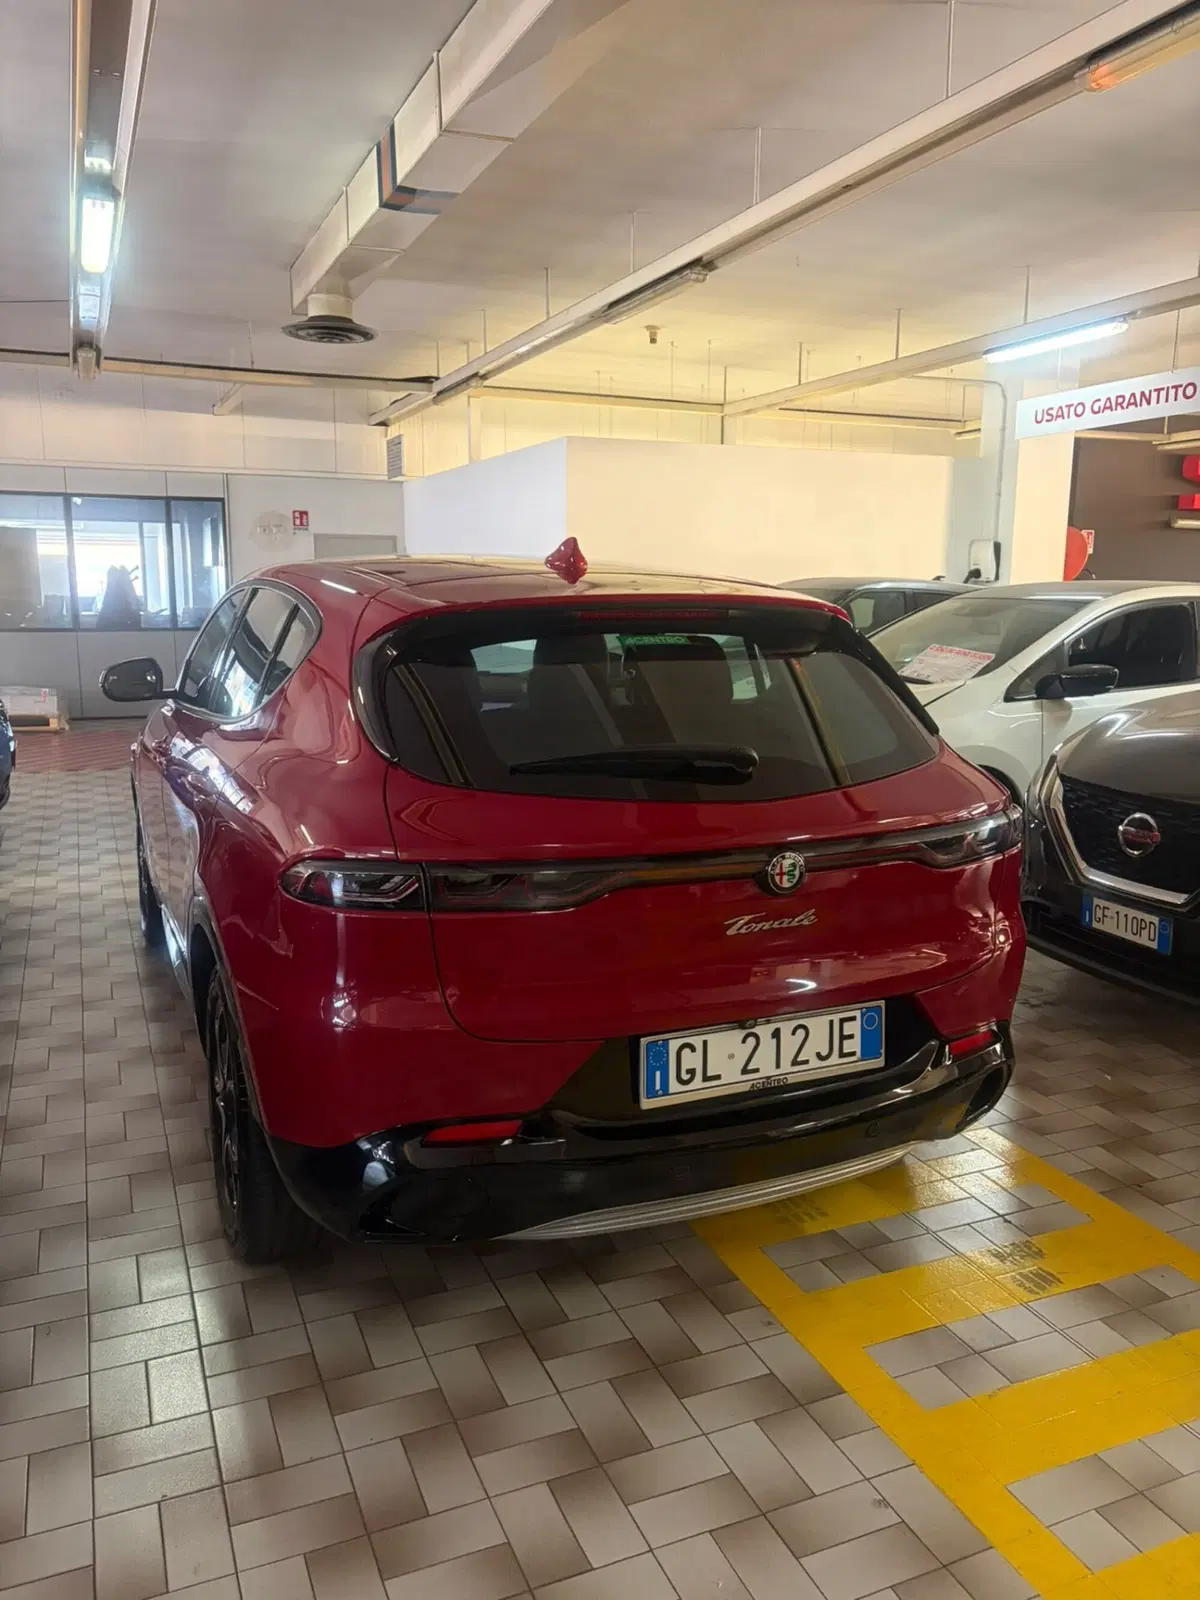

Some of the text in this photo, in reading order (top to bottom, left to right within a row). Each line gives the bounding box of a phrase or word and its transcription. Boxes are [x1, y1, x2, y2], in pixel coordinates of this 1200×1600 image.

[1034, 381, 1198, 424] USATO GARANTITO
[724, 908, 818, 936] Tonale
[748, 1076, 789, 1093] ACENTRO
